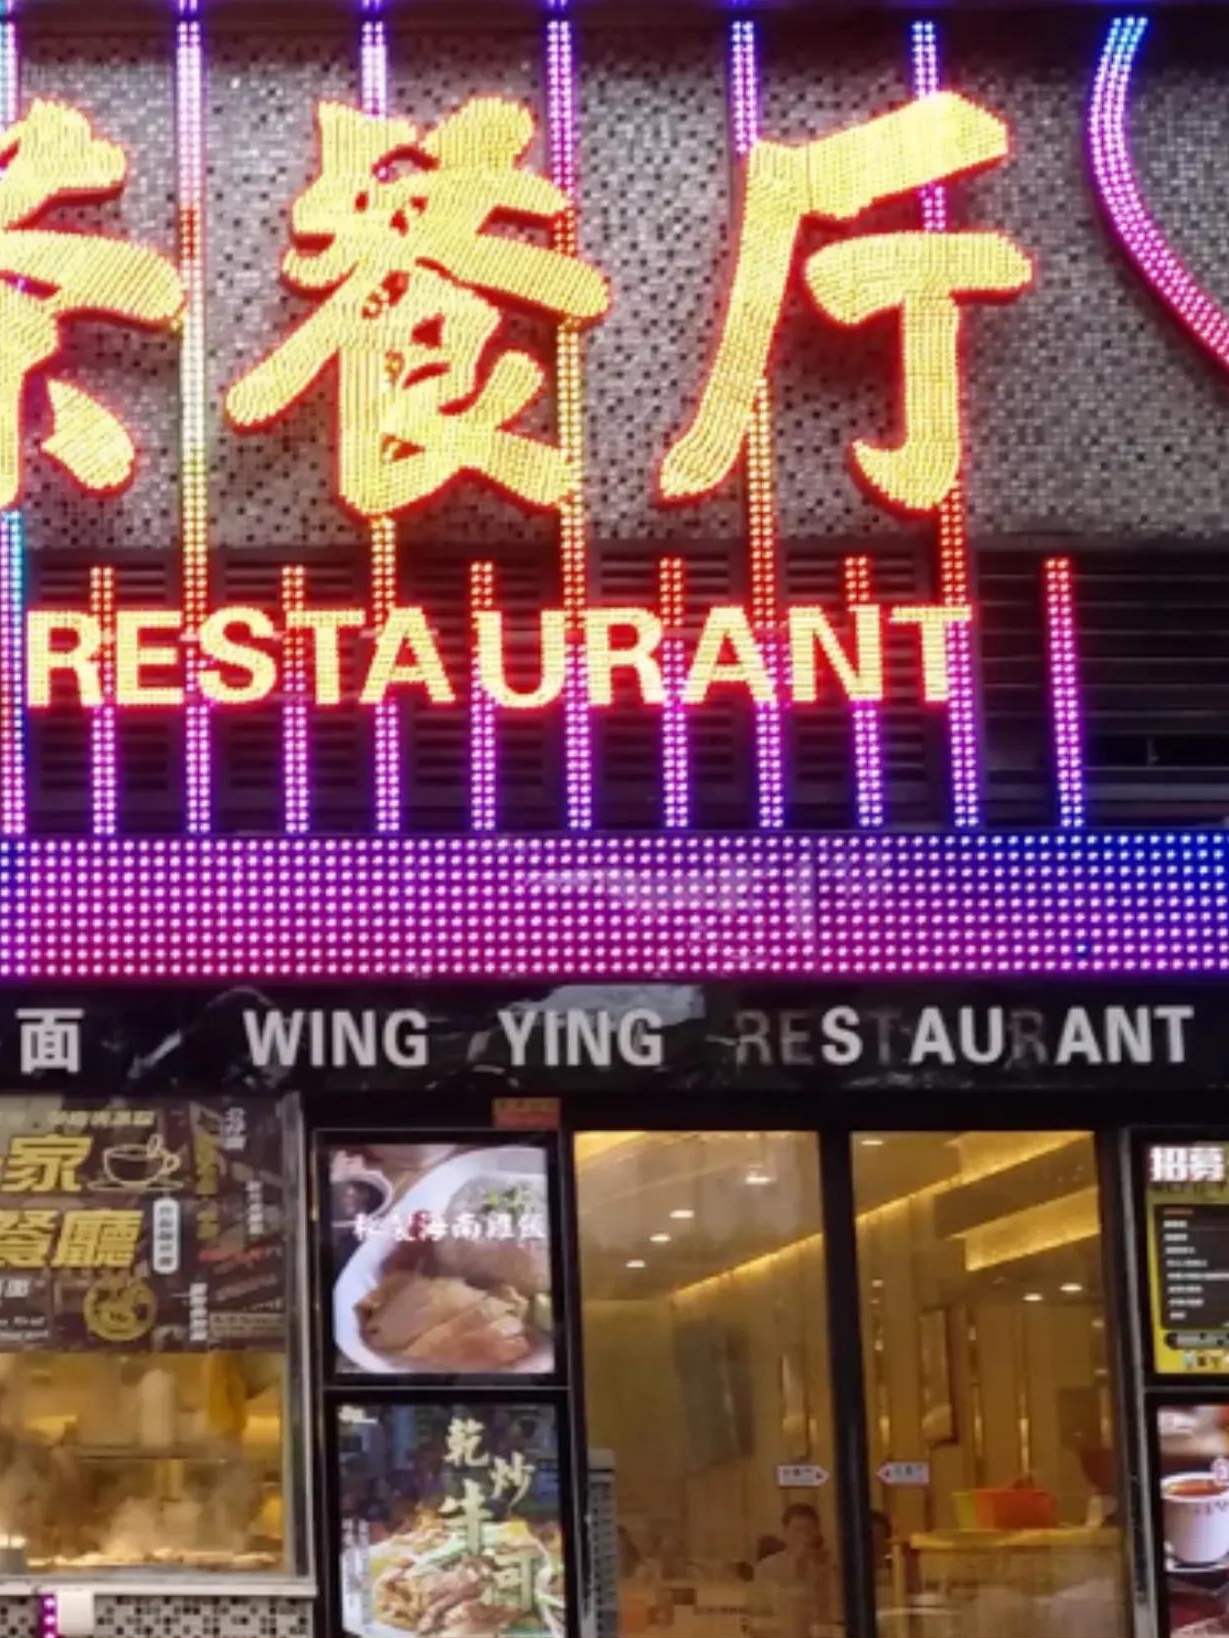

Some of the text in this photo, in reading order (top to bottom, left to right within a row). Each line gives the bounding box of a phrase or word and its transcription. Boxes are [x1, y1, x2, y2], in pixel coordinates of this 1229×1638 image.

[24, 605, 974, 709] RESTAURANT
[243, 1005, 1195, 1069] WING YING RESTAURANT
